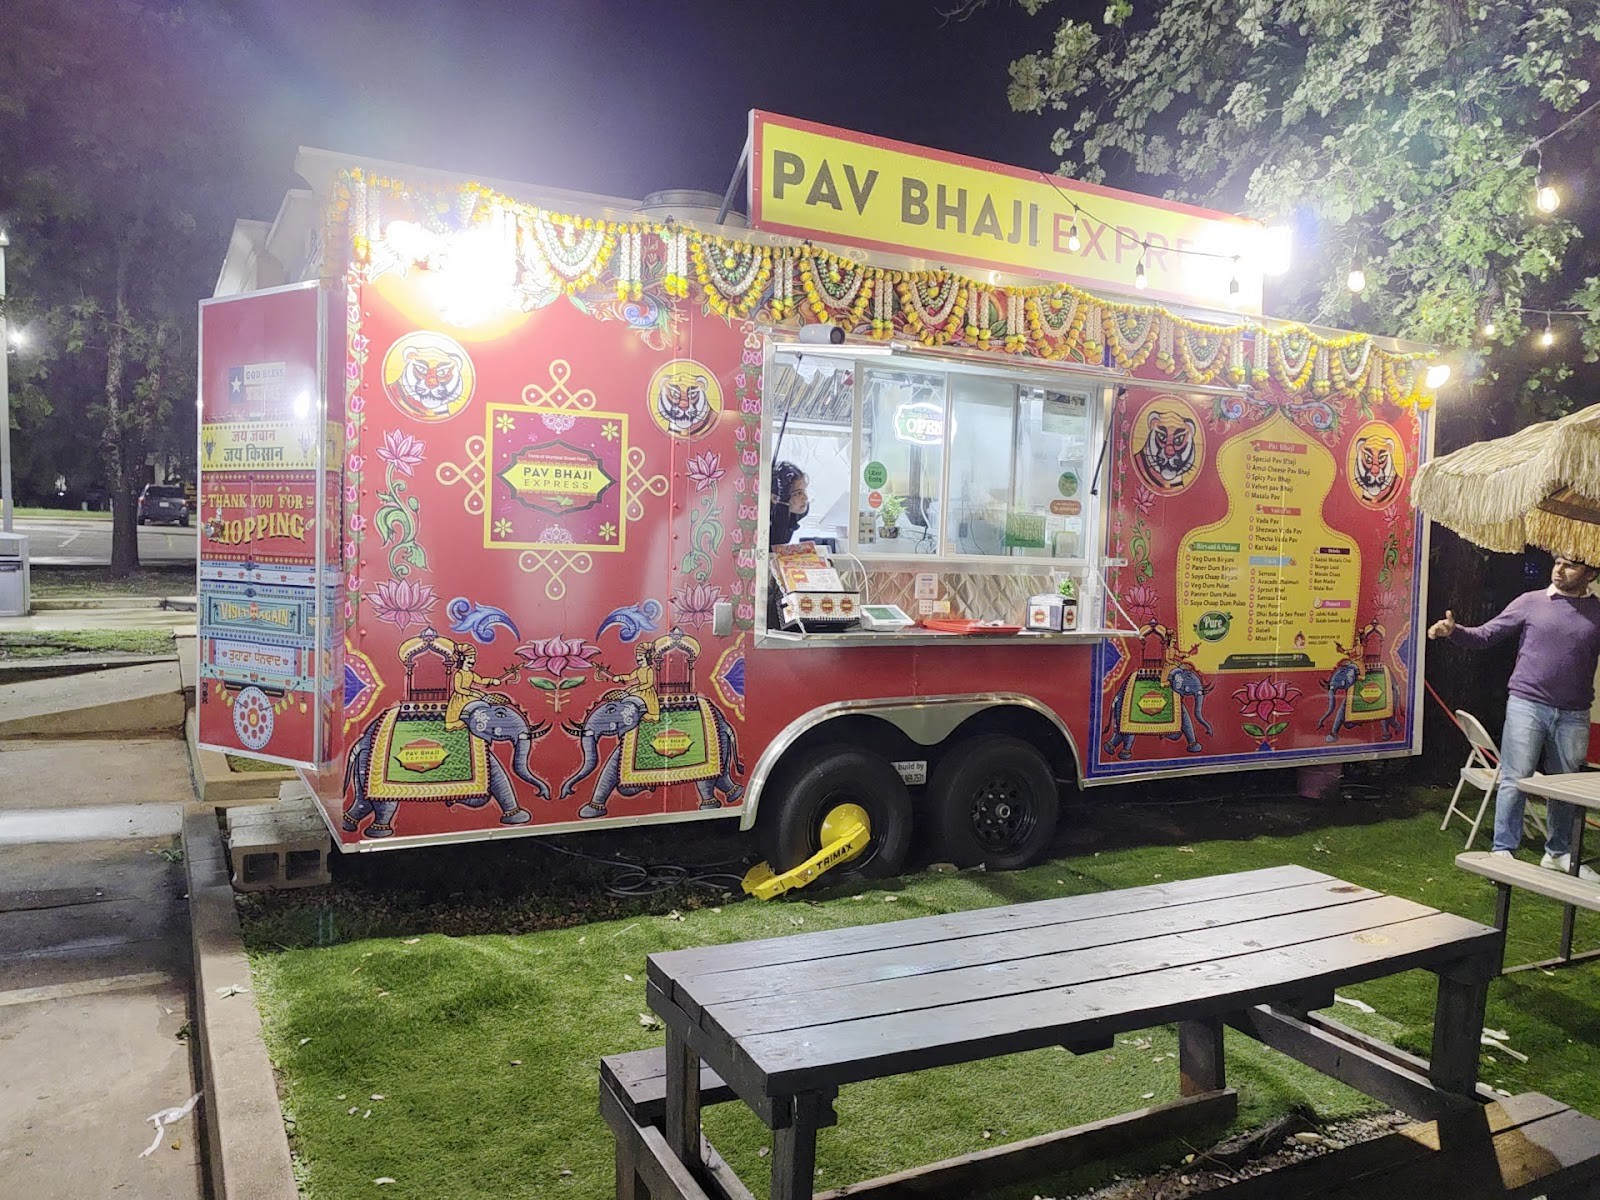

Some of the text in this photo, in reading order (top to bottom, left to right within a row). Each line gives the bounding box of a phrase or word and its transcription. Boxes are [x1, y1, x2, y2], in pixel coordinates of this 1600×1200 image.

[773, 150, 879, 216] PAV
[901, 176, 1039, 247] BHAJI
[245, 370, 260, 380] GOD
[906, 417, 944, 436] OPEN
[231, 430, 276, 442] जय जवान
[223, 444, 284, 462] जय किसान
[1252, 455, 1297, 466] Special Pav Bhaji
[523, 467, 592, 480] PAV BHAJI
[1297, 468, 1311, 476] Bhaji
[524, 479, 589, 489] EXPRESS
[1252, 474, 1265, 482] Spicy
[1278, 476, 1291, 484] Bhaji
[1280, 485, 1294, 493] Bhaji
[208, 494, 304, 509] THANK YOU FOR
[1196, 543, 1216, 551] Biryani
[1192, 556, 1203, 564] Veg
[1221, 565, 1238, 573] Biryani
[1220, 574, 1238, 582] Biryani
[1191, 582, 1202, 590] Veg
[1257, 586, 1274, 594] Sprout
[1190, 600, 1203, 608] Soya
[1203, 599, 1219, 607] Chaap
[220, 602, 248, 620] VISIT
[260, 607, 289, 628] AGAIN
[1202, 616, 1223, 629] Pure
[916, 763, 924, 771] by
[816, 842, 854, 870] TRIMAX
